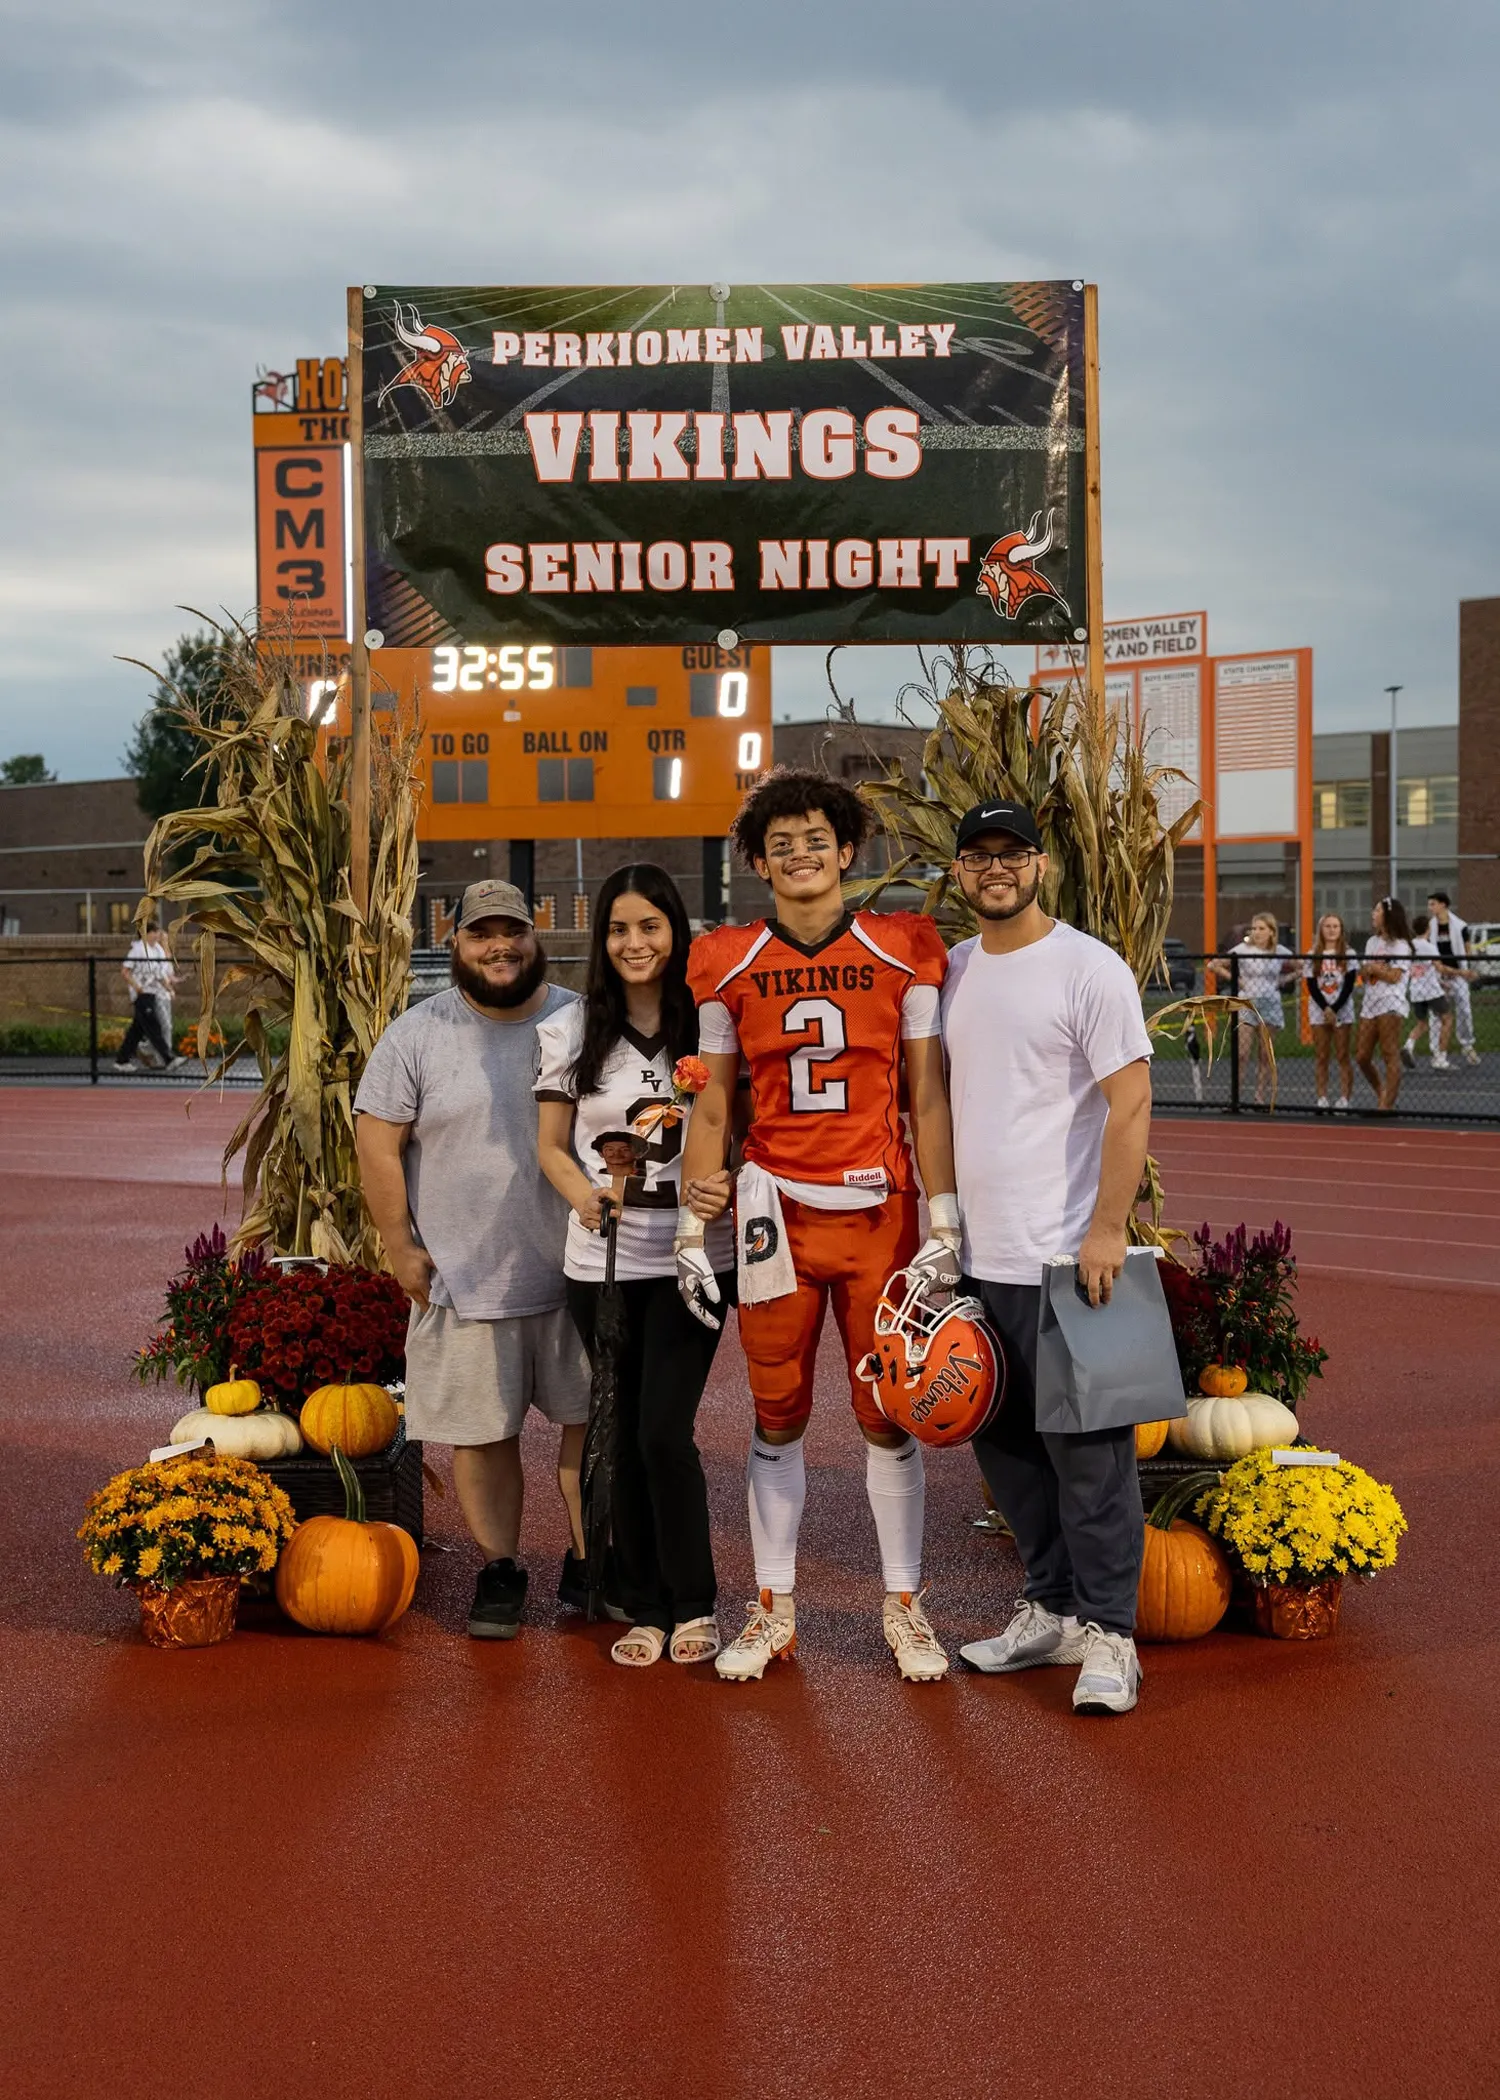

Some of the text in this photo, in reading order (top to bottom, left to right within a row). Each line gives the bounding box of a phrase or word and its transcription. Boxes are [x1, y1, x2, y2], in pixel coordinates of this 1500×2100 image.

[492, 322, 957, 368] PERKIOMEN VALLEY
[297, 357, 350, 412] HO
[524, 407, 923, 483] VIKINGS
[484, 536, 971, 595] SENIOR NIGHT
[1143, 619, 1198, 637] VALLEY
[682, 646, 753, 670] GUEST
[1063, 636, 1198, 663] TRK AND FIELD
[431, 645, 555, 692] 32:55
[719, 671, 748, 717] 0
[430, 732, 490, 755] TO GO
[523, 730, 608, 753] BALL ON
[647, 729, 687, 751] QTR
[738, 732, 762, 770] 0
[750, 964, 876, 998] VIKINGS
[781, 996, 849, 1114] 2
[848, 1171, 883, 1182] Riddell
